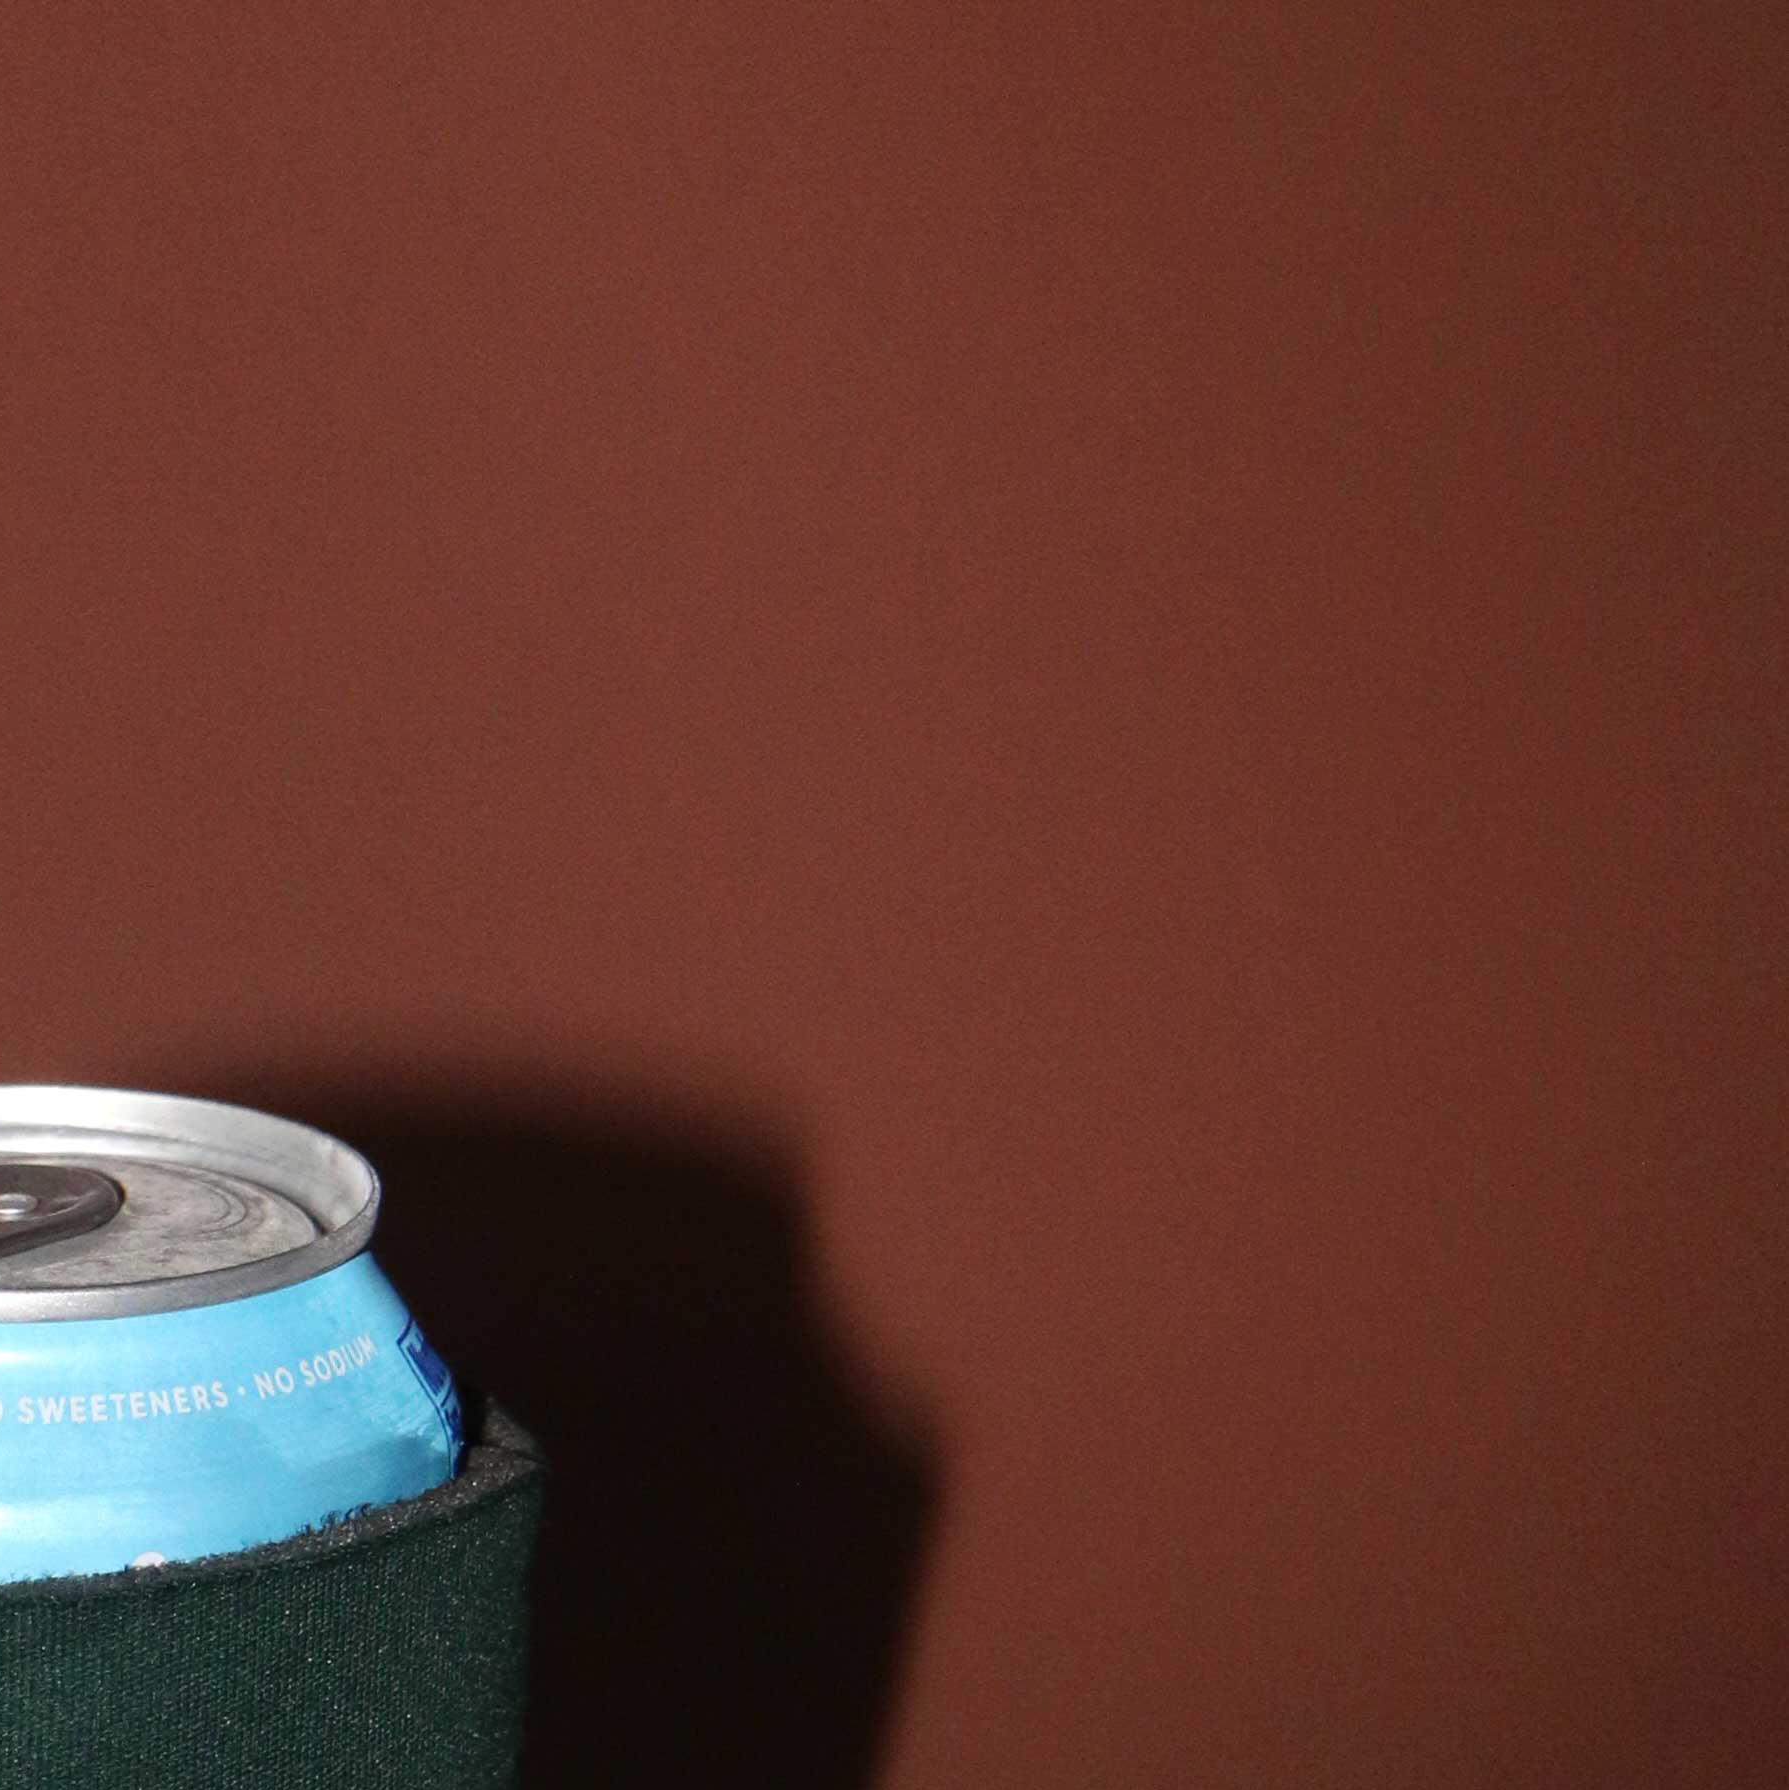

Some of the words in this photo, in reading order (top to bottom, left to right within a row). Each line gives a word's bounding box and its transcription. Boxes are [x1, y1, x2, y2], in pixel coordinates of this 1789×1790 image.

[17, 1380, 230, 1425] SWEETENERS
[252, 1366, 295, 1400] NO
[299, 1334, 378, 1387] SODIUM
